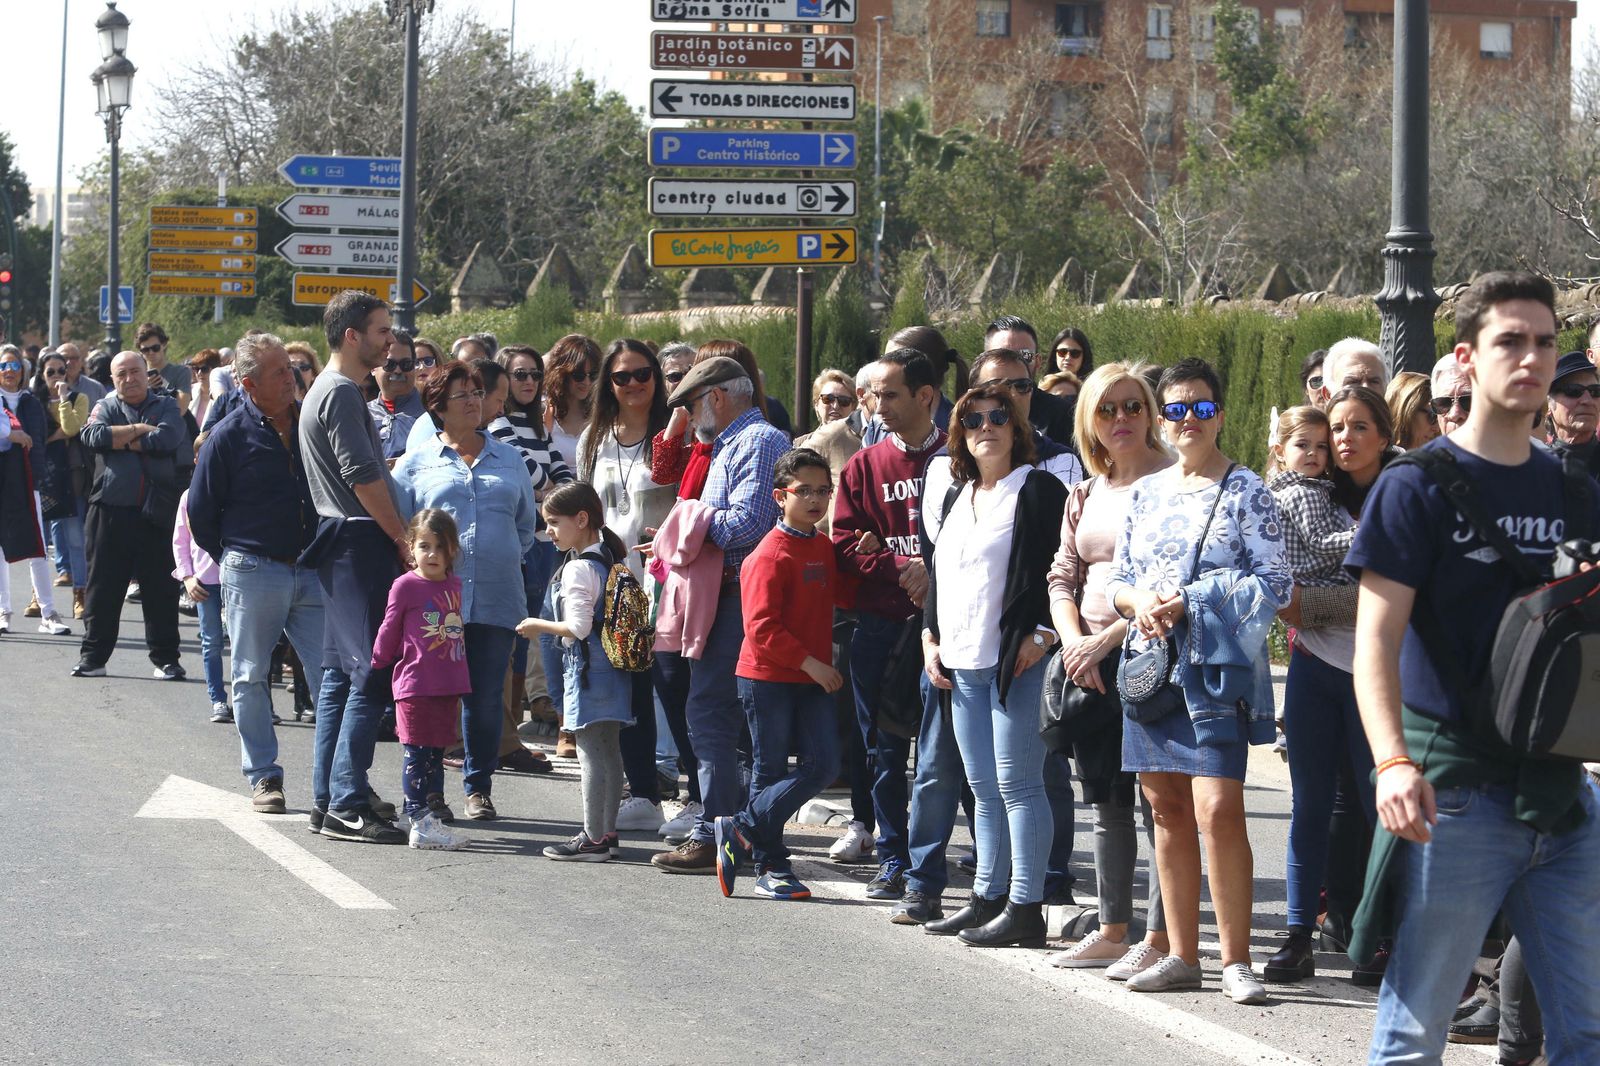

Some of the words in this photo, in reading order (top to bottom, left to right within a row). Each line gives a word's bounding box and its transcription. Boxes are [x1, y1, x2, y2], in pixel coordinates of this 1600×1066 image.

[658, 3, 710, 16] Rina
[659, 36, 711, 50] jardín
[717, 38, 793, 51] botánico
[659, 51, 747, 66] zoológico
[690, 92, 743, 107] TODAS
[746, 94, 850, 109] DIRECCIONES
[662, 136, 680, 160] P
[728, 138, 770, 150] Parking
[697, 149, 740, 160] Centro
[744, 150, 800, 161] Histórico
[369, 162, 401, 173] Sevill
[369, 174, 401, 185] Madri
[658, 191, 716, 204] centro
[725, 190, 786, 205] ciudad
[357, 205, 399, 218] MÁLAG
[347, 240, 399, 251] GRANAD
[802, 236, 817, 257] P
[353, 253, 398, 264] BADAJO
[881, 477, 922, 502] LON
